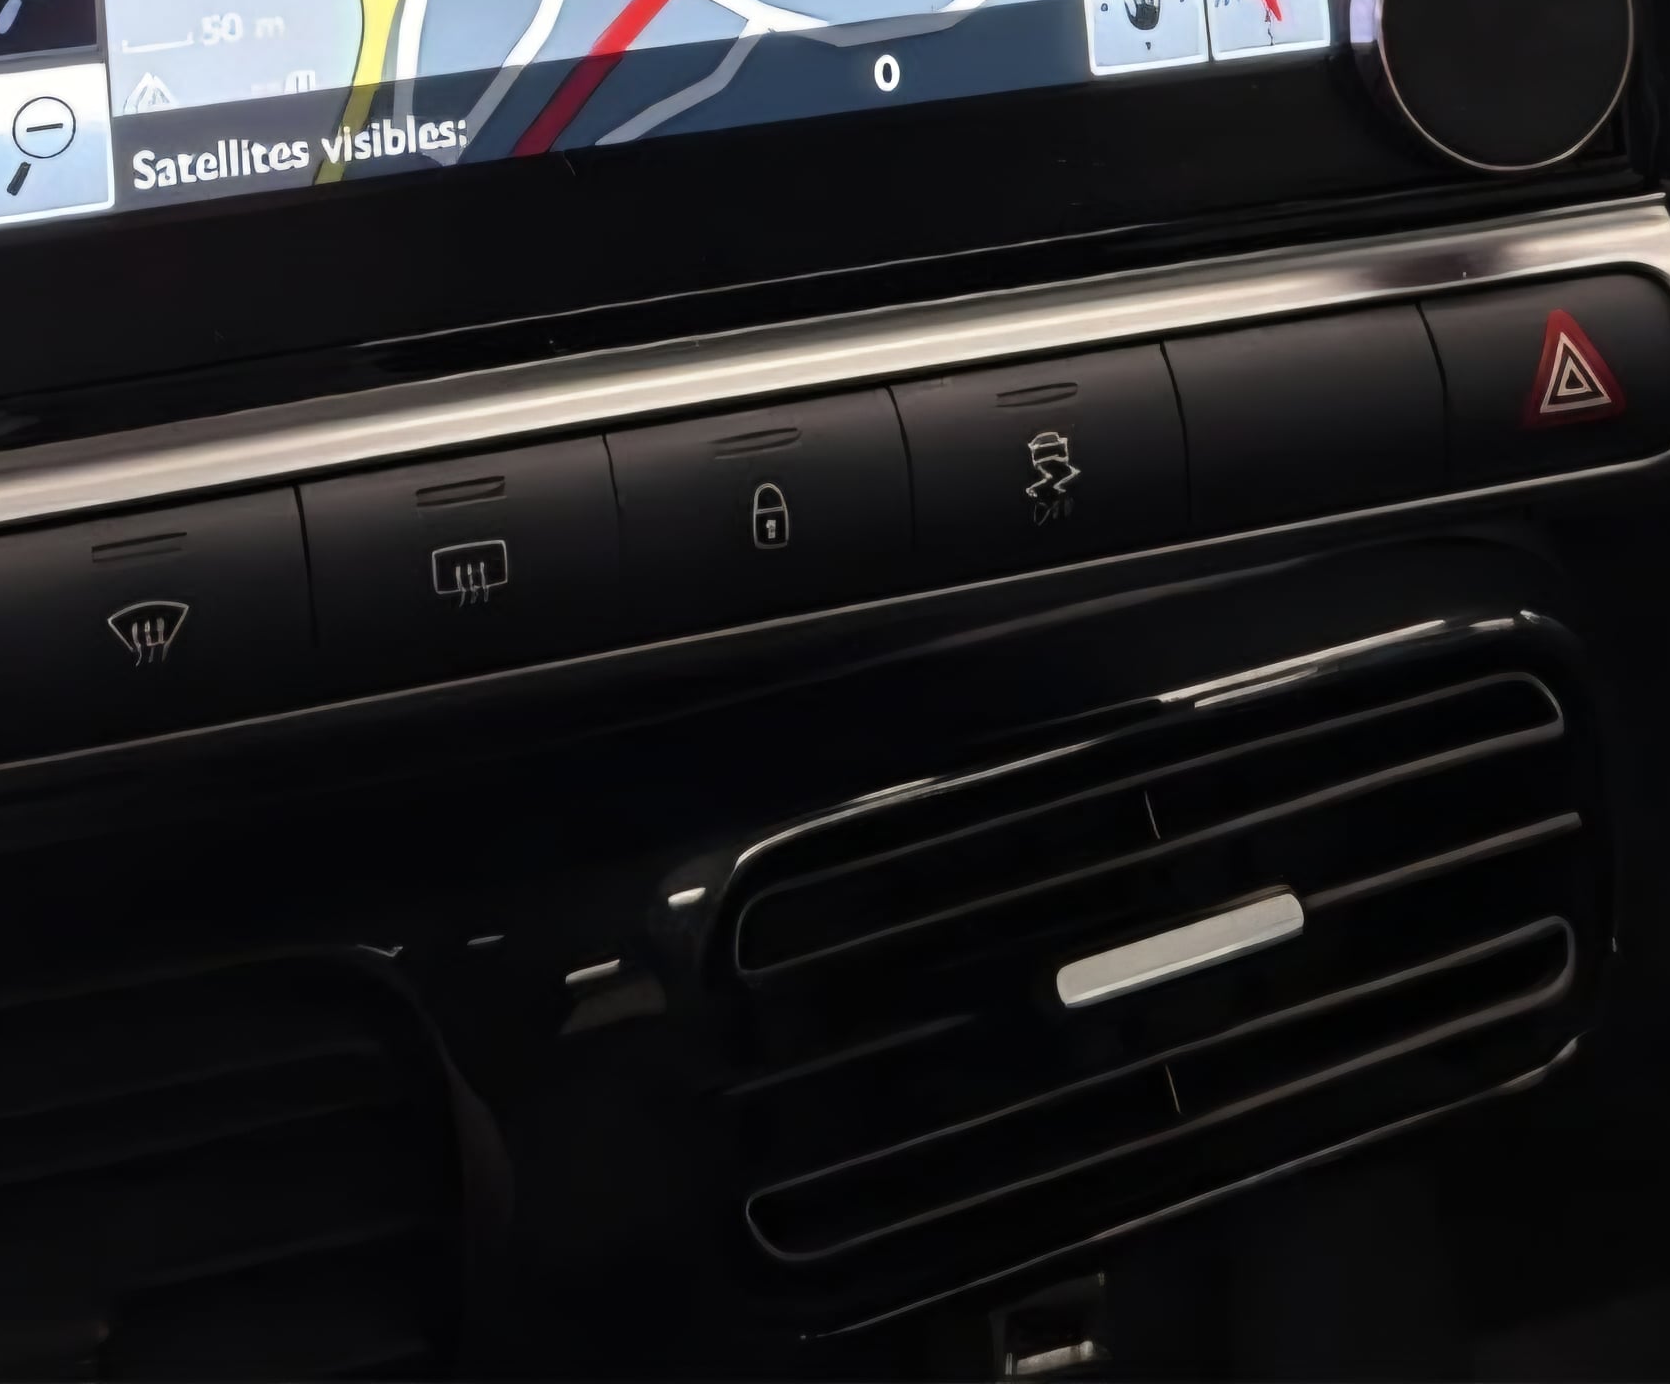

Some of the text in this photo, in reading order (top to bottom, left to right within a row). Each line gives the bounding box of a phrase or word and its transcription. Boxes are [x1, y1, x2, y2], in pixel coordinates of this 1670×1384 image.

[201, 12, 244, 46] 50
[132, 54, 901, 191] Satellites visibles: 0
